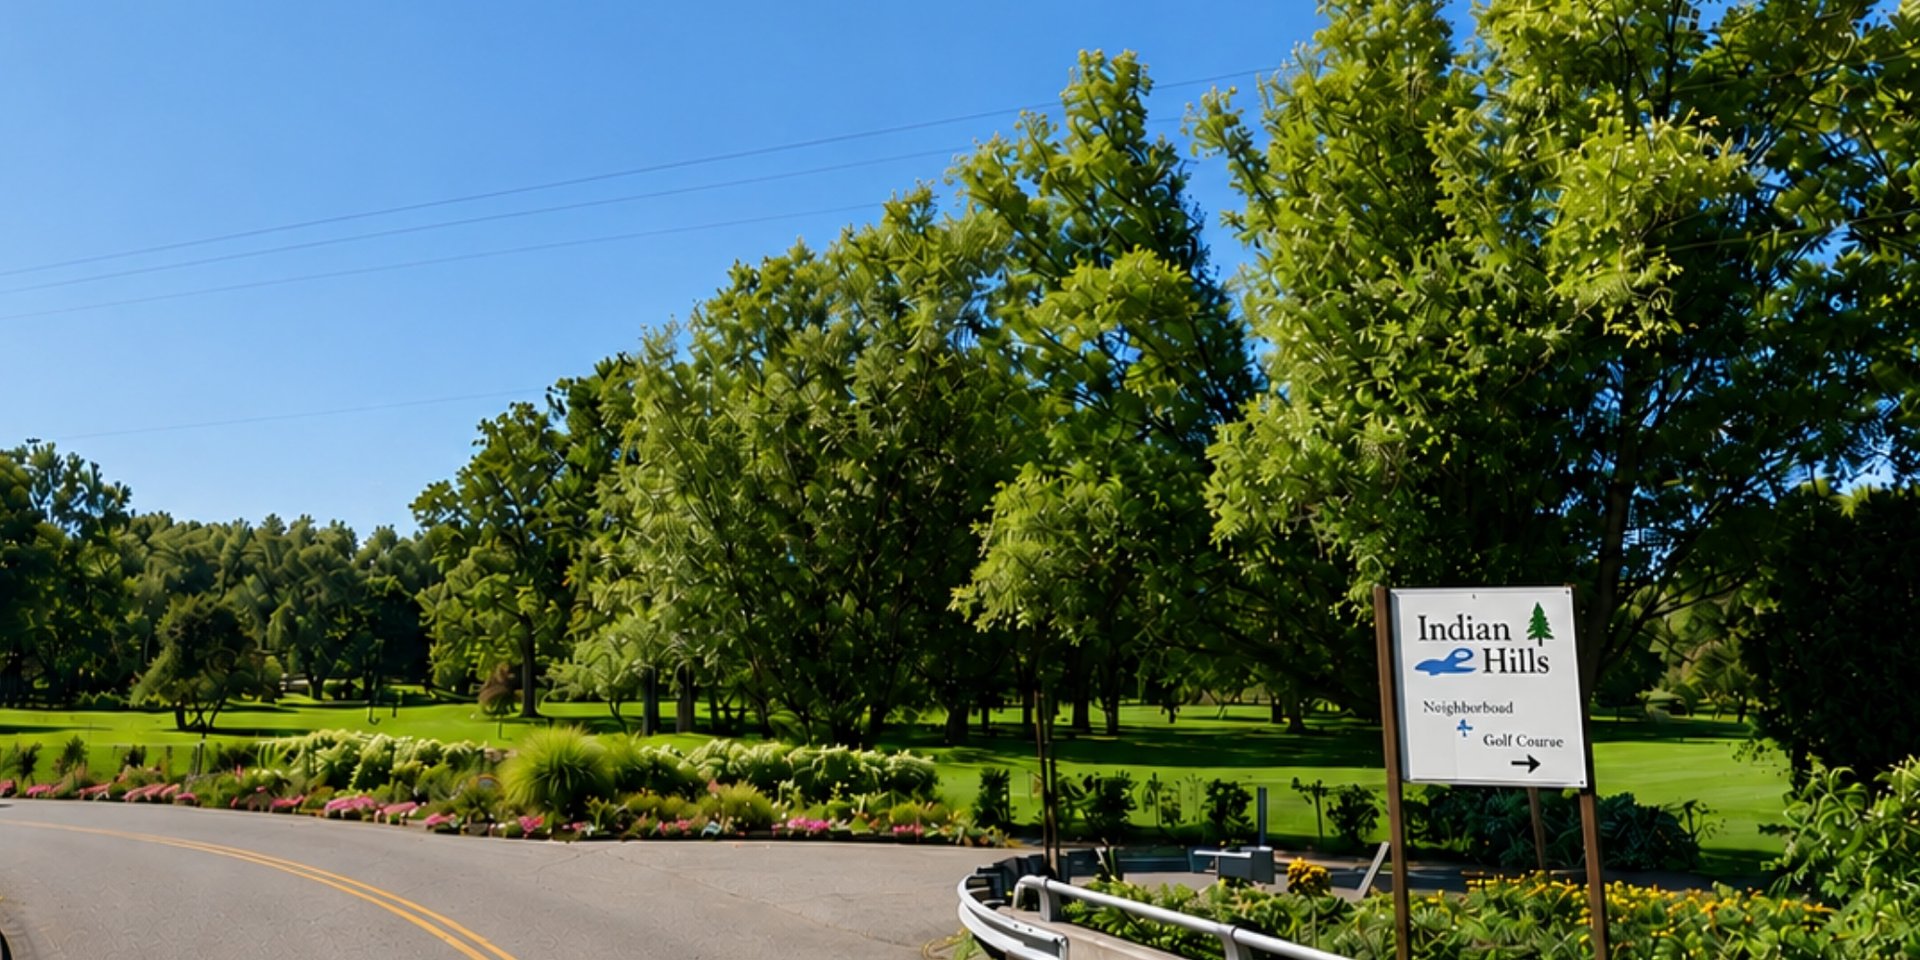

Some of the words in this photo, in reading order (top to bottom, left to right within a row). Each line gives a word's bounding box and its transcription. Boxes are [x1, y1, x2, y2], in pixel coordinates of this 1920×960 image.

[1417, 614, 1511, 641] Indian
[1483, 648, 1549, 674] Hills
[1483, 734, 1512, 747] Golf
